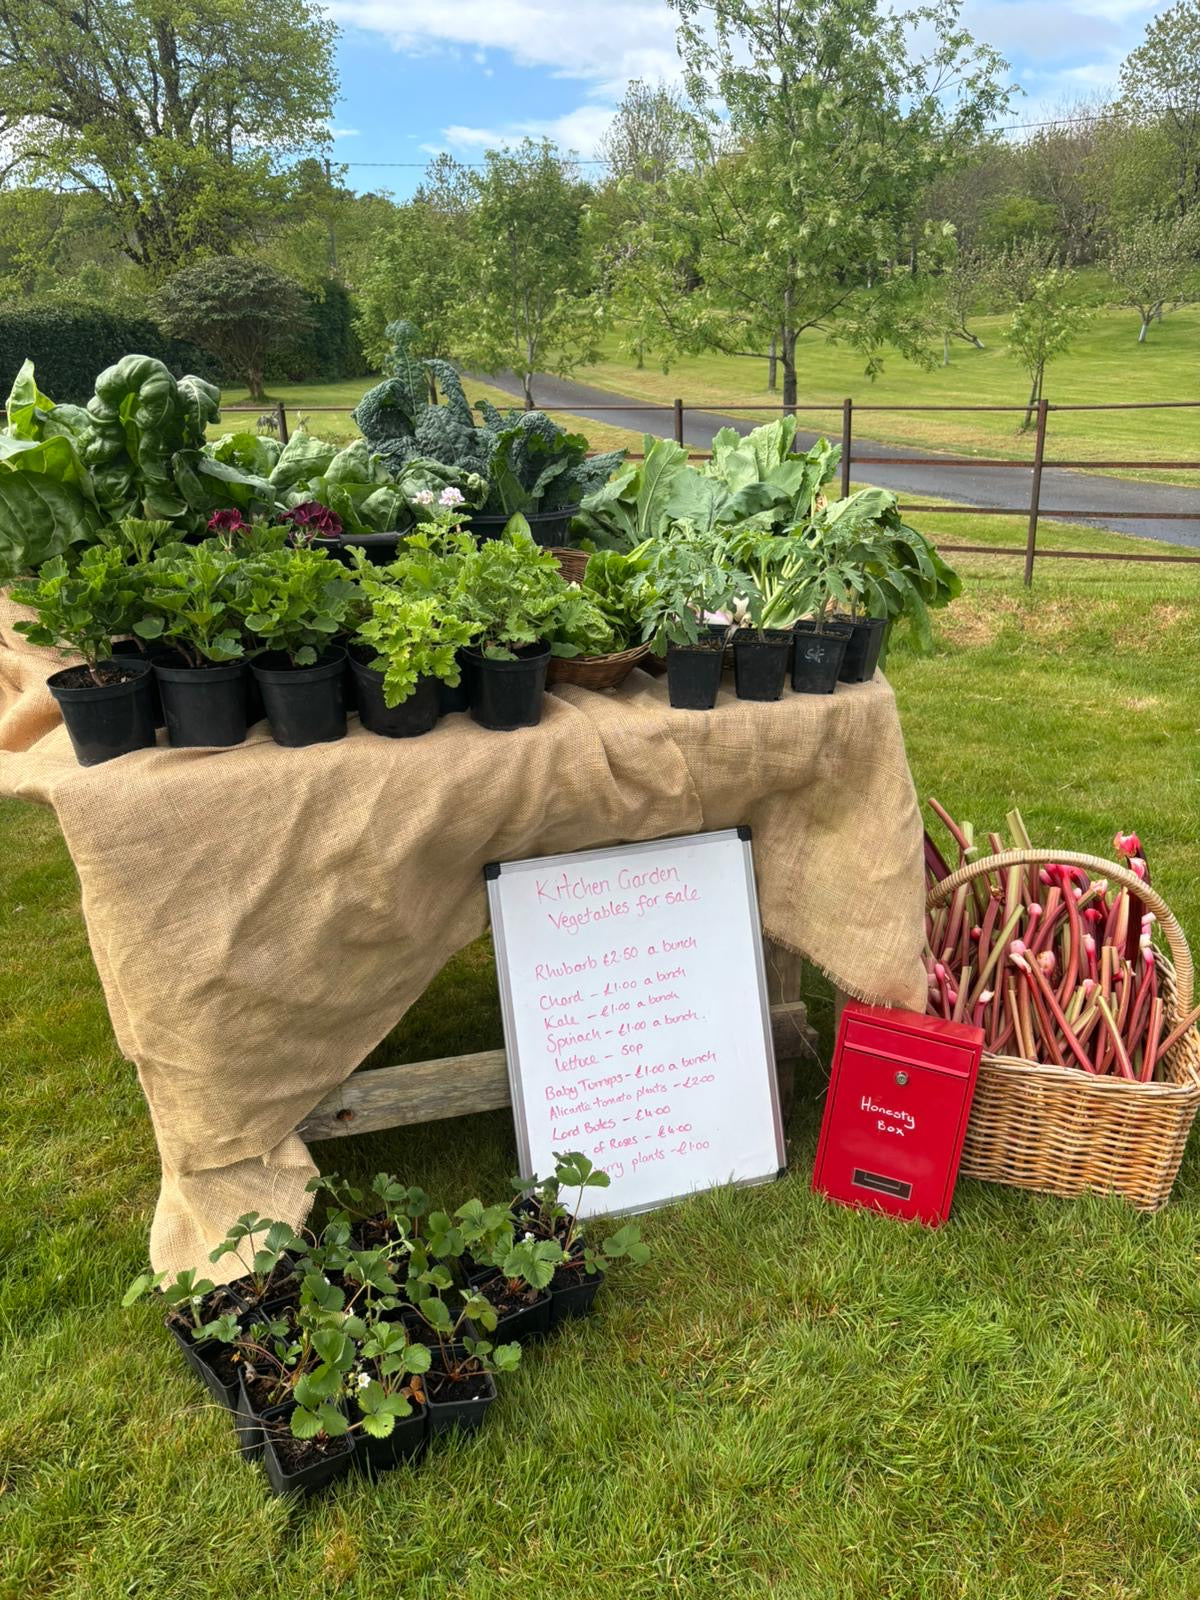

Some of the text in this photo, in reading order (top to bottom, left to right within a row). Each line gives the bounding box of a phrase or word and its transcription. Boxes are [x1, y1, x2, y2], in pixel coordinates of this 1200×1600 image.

[535, 867, 680, 904] Kitchen Garden
[548, 884, 701, 936] Vegetables for sale
[535, 936, 697, 981] Rhubarb £2.50 a bunch
[603, 980, 638, 997] £1.00
[644, 977, 653, 985] a
[656, 966, 687, 982] bunch
[544, 1013, 580, 1030] Kale
[600, 1002, 631, 1018] £1.00
[648, 991, 680, 1005] bunch
[546, 1028, 602, 1056] Spinach
[618, 1021, 647, 1037] £1.00
[652, 1019, 662, 1027] a
[545, 1085, 579, 1101] Baby
[577, 1073, 624, 1092] Turnips
[668, 1062, 678, 1071] a
[681, 1050, 716, 1067] bunch
[592, 1092, 633, 1108] tomato
[636, 1083, 668, 1102] plants
[861, 1095, 915, 1130] Honesty
[552, 1125, 581, 1141] Lord
[593, 1140, 607, 1154] of
[609, 1135, 639, 1150] Roses
[877, 1120, 905, 1136] Box
[631, 1148, 665, 1173] plants
